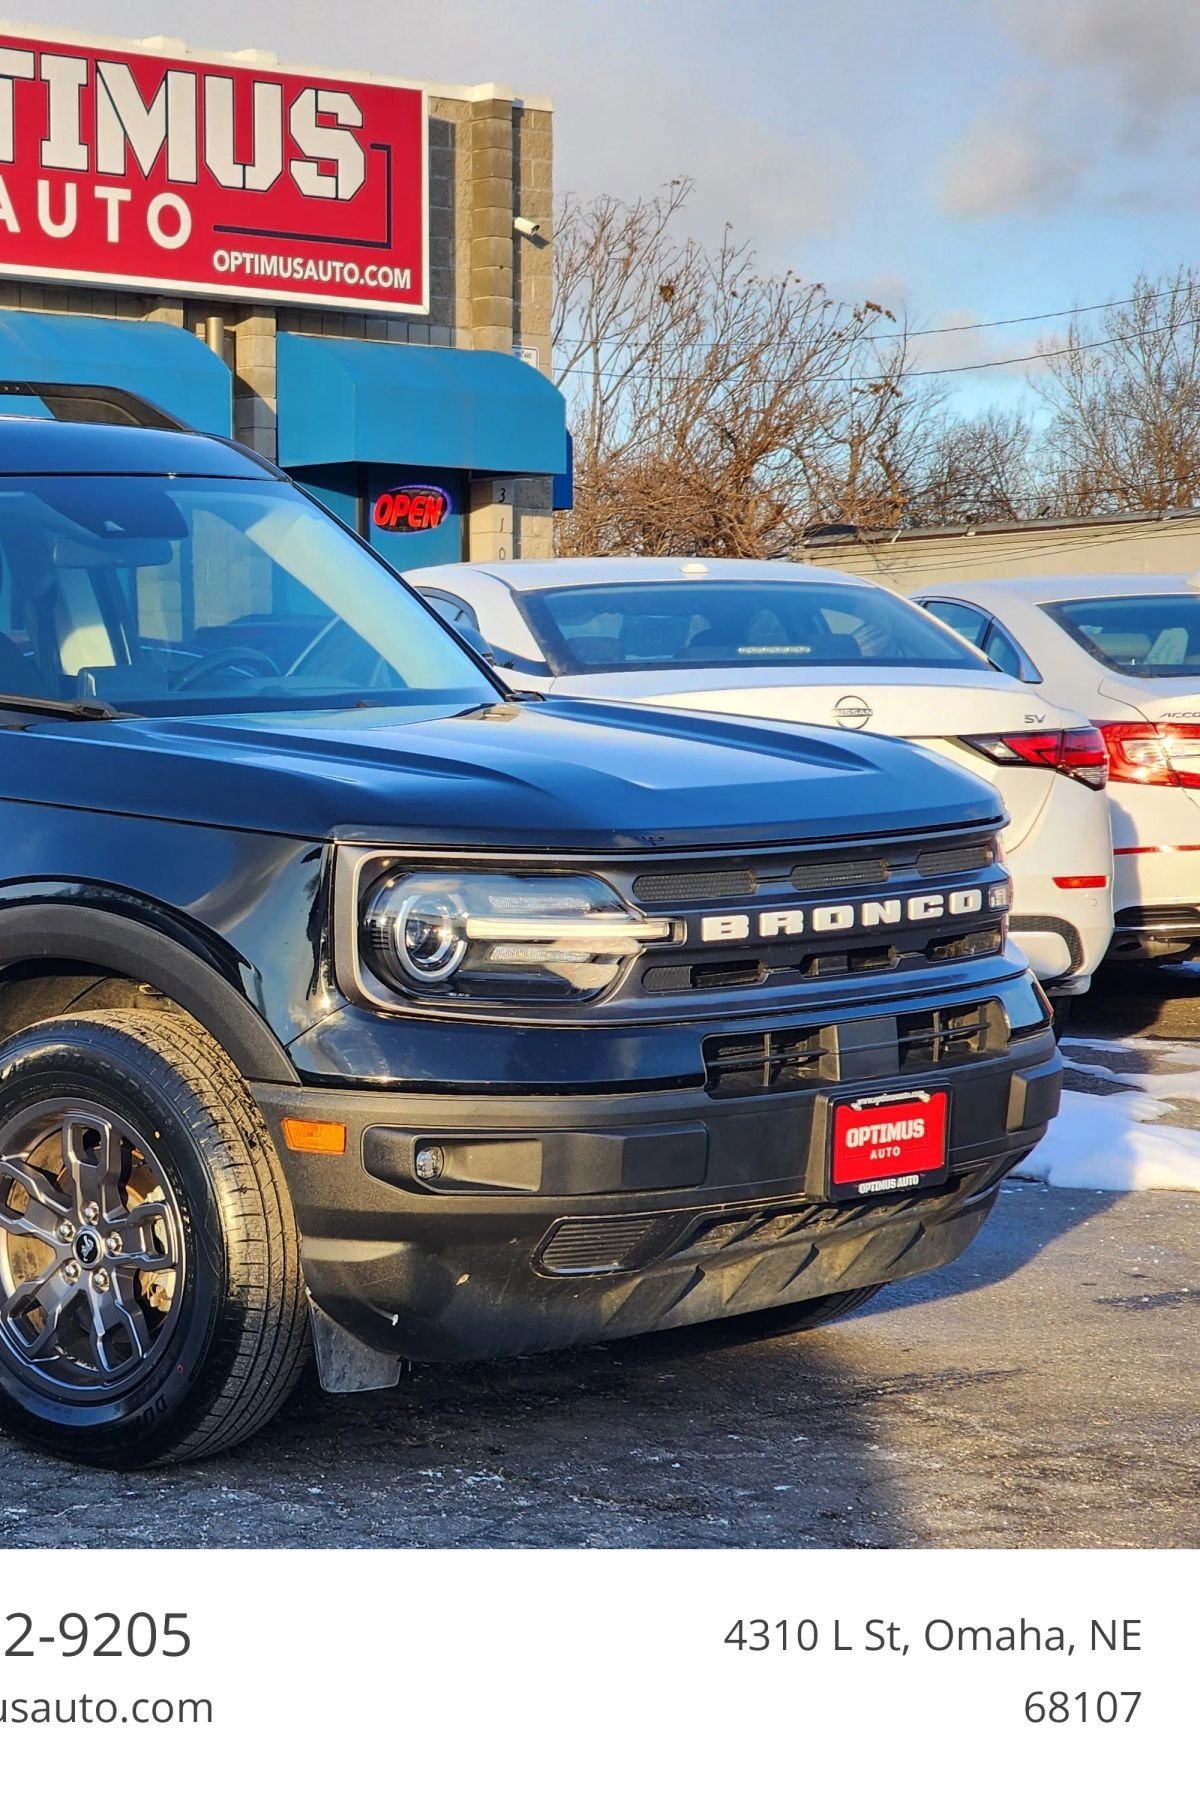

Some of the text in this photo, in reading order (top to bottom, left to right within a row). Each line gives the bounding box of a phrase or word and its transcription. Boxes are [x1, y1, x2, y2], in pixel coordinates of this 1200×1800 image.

[213, 249, 412, 290] OPTIMUSAUTO.COM
[373, 493, 443, 528] OPEN
[1024, 714, 1046, 724] SV
[701, 889, 983, 942] BRONCO
[846, 1118, 925, 1148] OPTIMUS
[870, 1146, 901, 1160] AUTO
[858, 1175, 919, 1194] OPTIMUS AUTO
